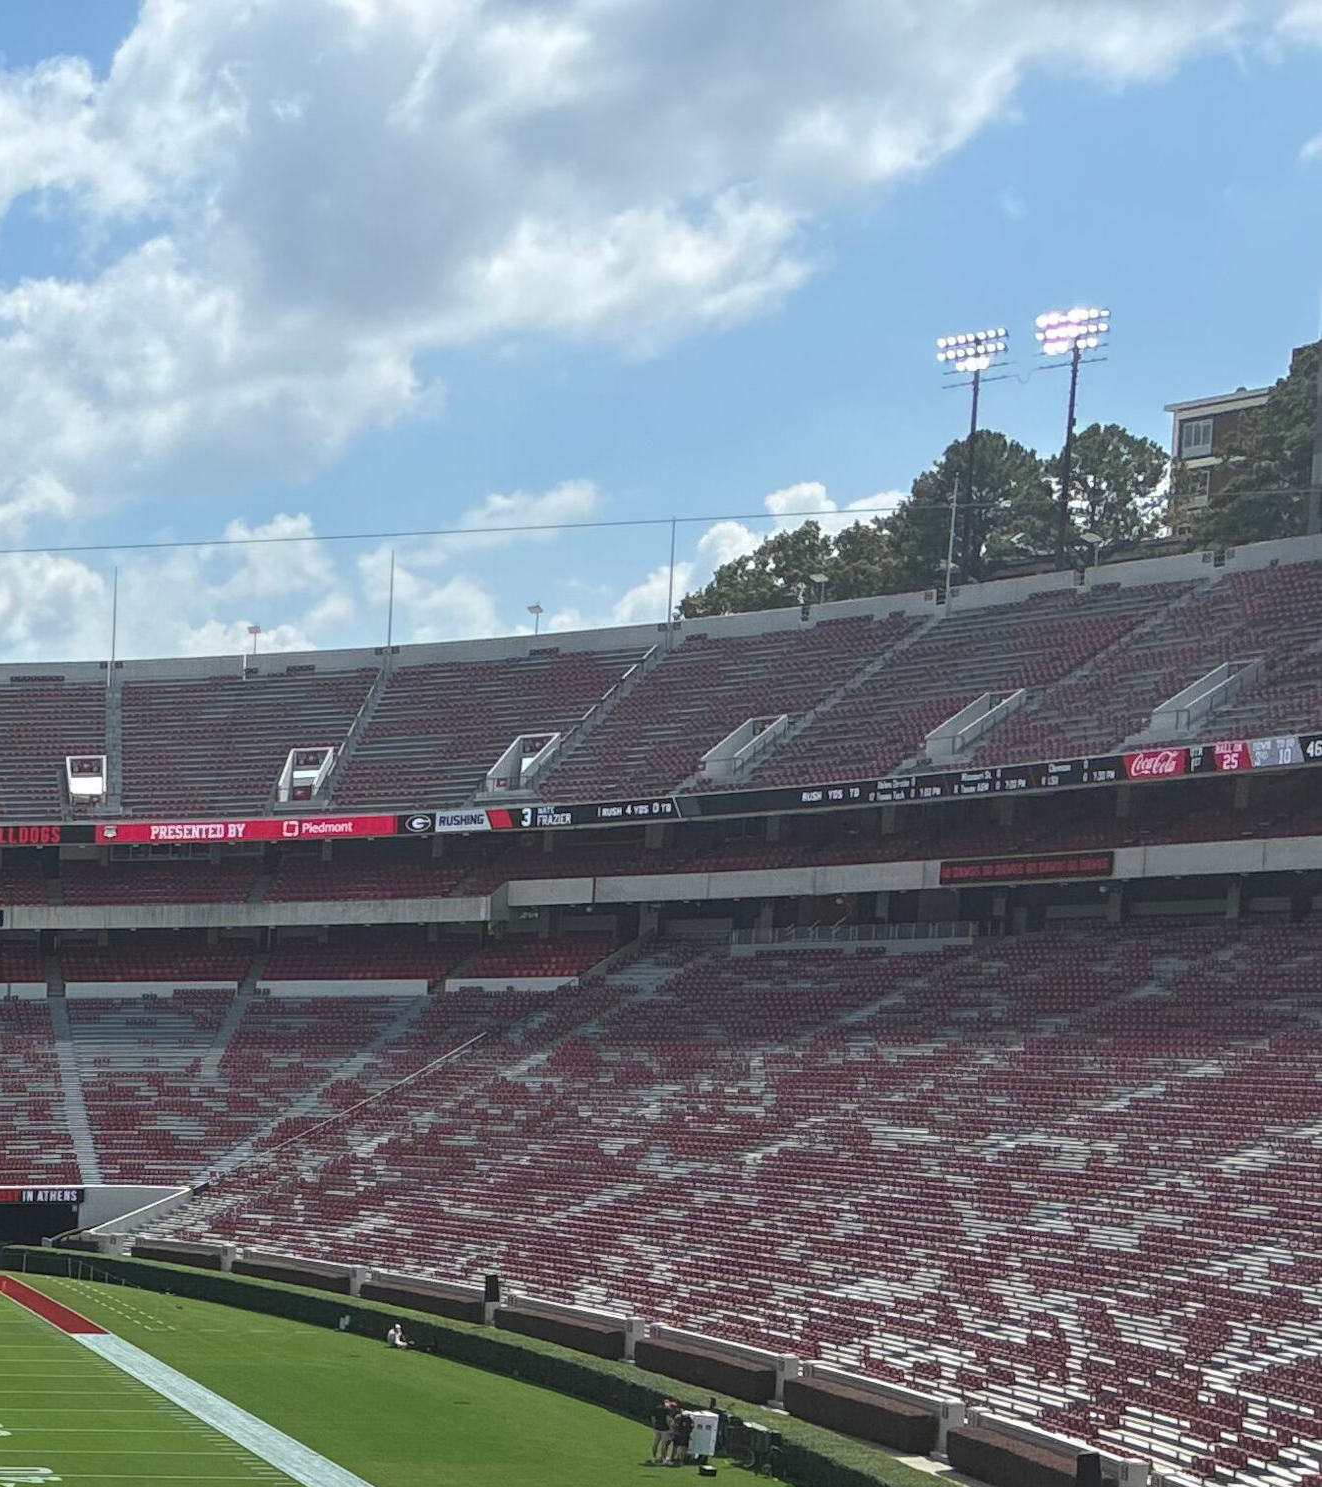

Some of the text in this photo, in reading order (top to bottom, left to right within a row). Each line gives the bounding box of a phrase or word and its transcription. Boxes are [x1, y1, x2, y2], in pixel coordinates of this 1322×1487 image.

[1223, 753, 1239, 770] 25
[1279, 749, 1291, 764] 10
[438, 813, 485, 827] RUSHING
[521, 808, 532, 827] 3
[537, 813, 572, 826] FRAZIER
[149, 823, 245, 840] PRESENTED BY
[301, 821, 353, 834] Piedmont
[22, 1190, 35, 1202] IN
[37, 1190, 78, 1202] ATHENS
